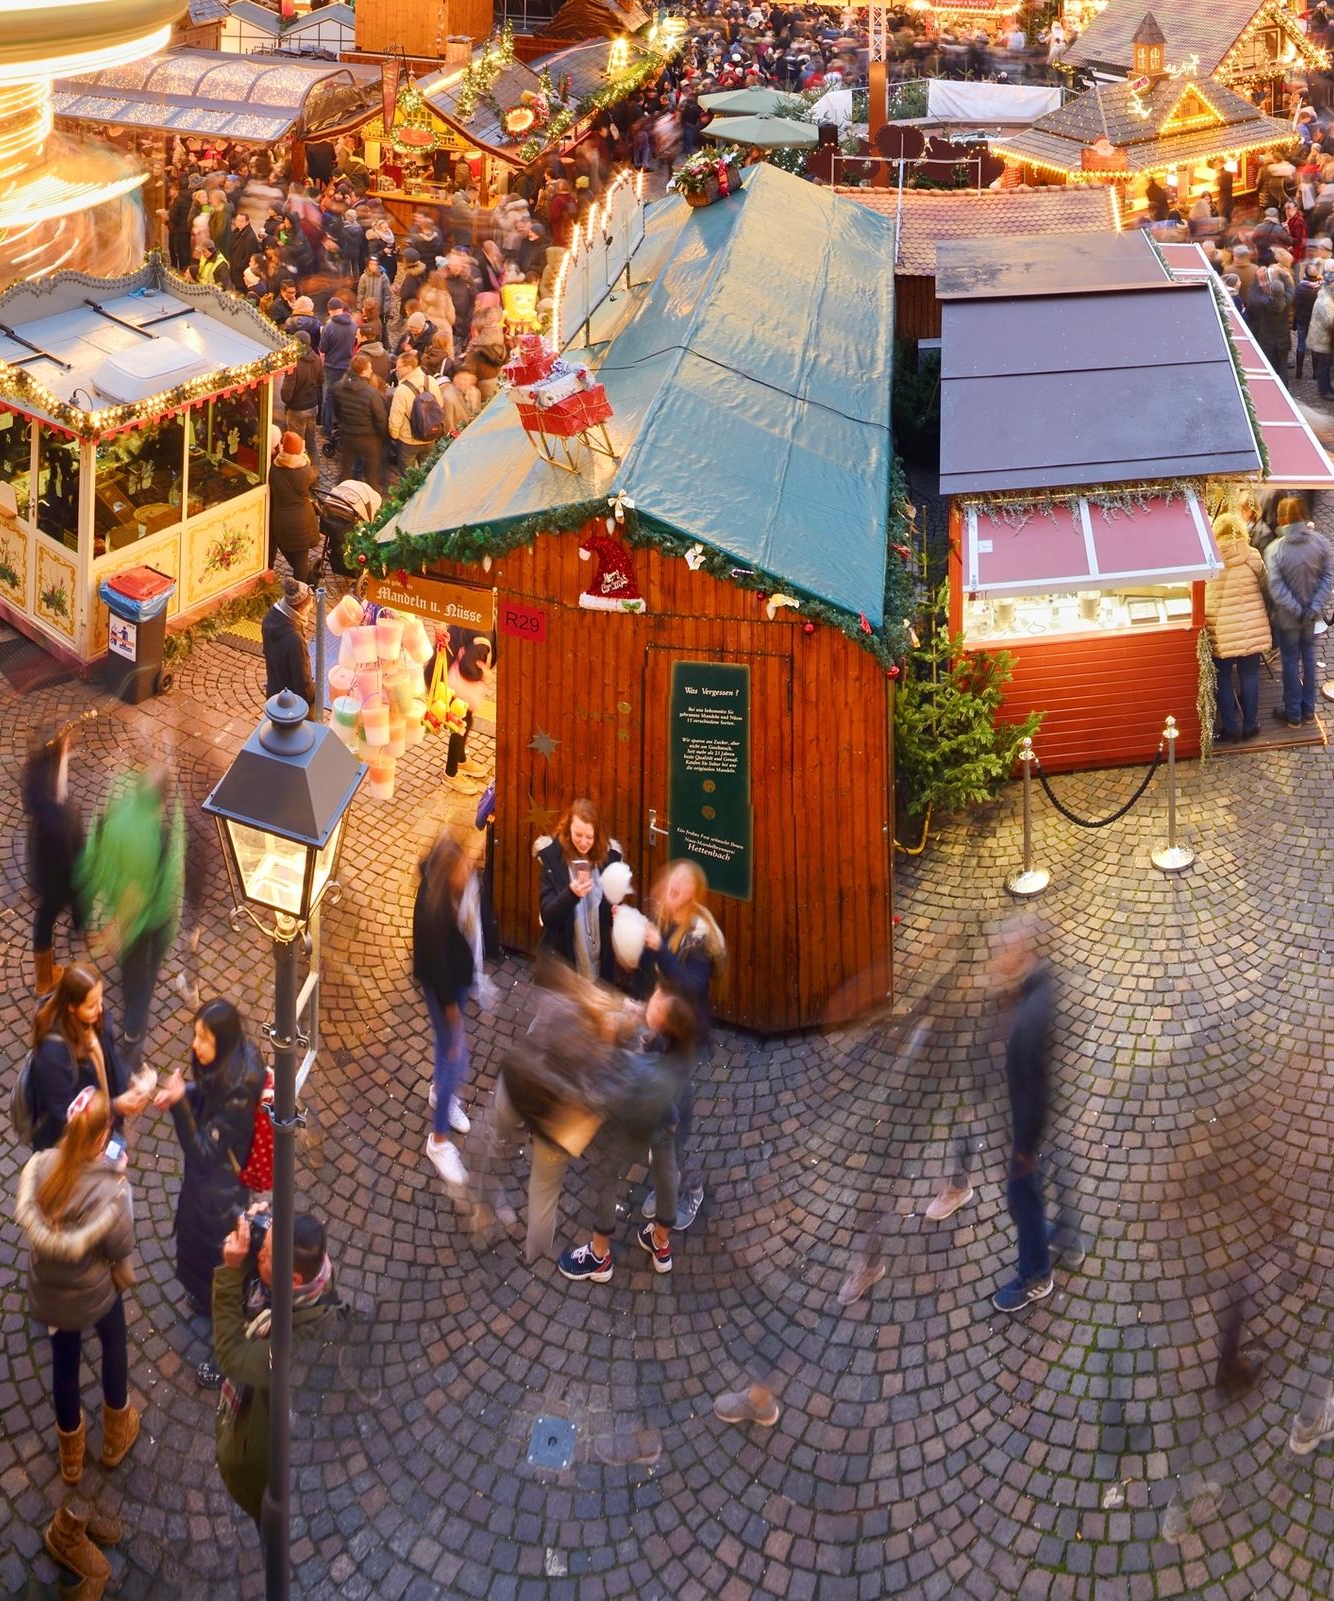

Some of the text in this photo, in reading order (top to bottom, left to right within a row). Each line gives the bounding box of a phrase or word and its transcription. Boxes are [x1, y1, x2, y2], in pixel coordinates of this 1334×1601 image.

[376, 586, 482, 623] Mandeln u. Nüsse
[505, 611, 540, 633] R29
[685, 687, 698, 695] Was
[702, 688, 733, 697] Vergessen
[688, 843, 731, 861] Hettenbach
